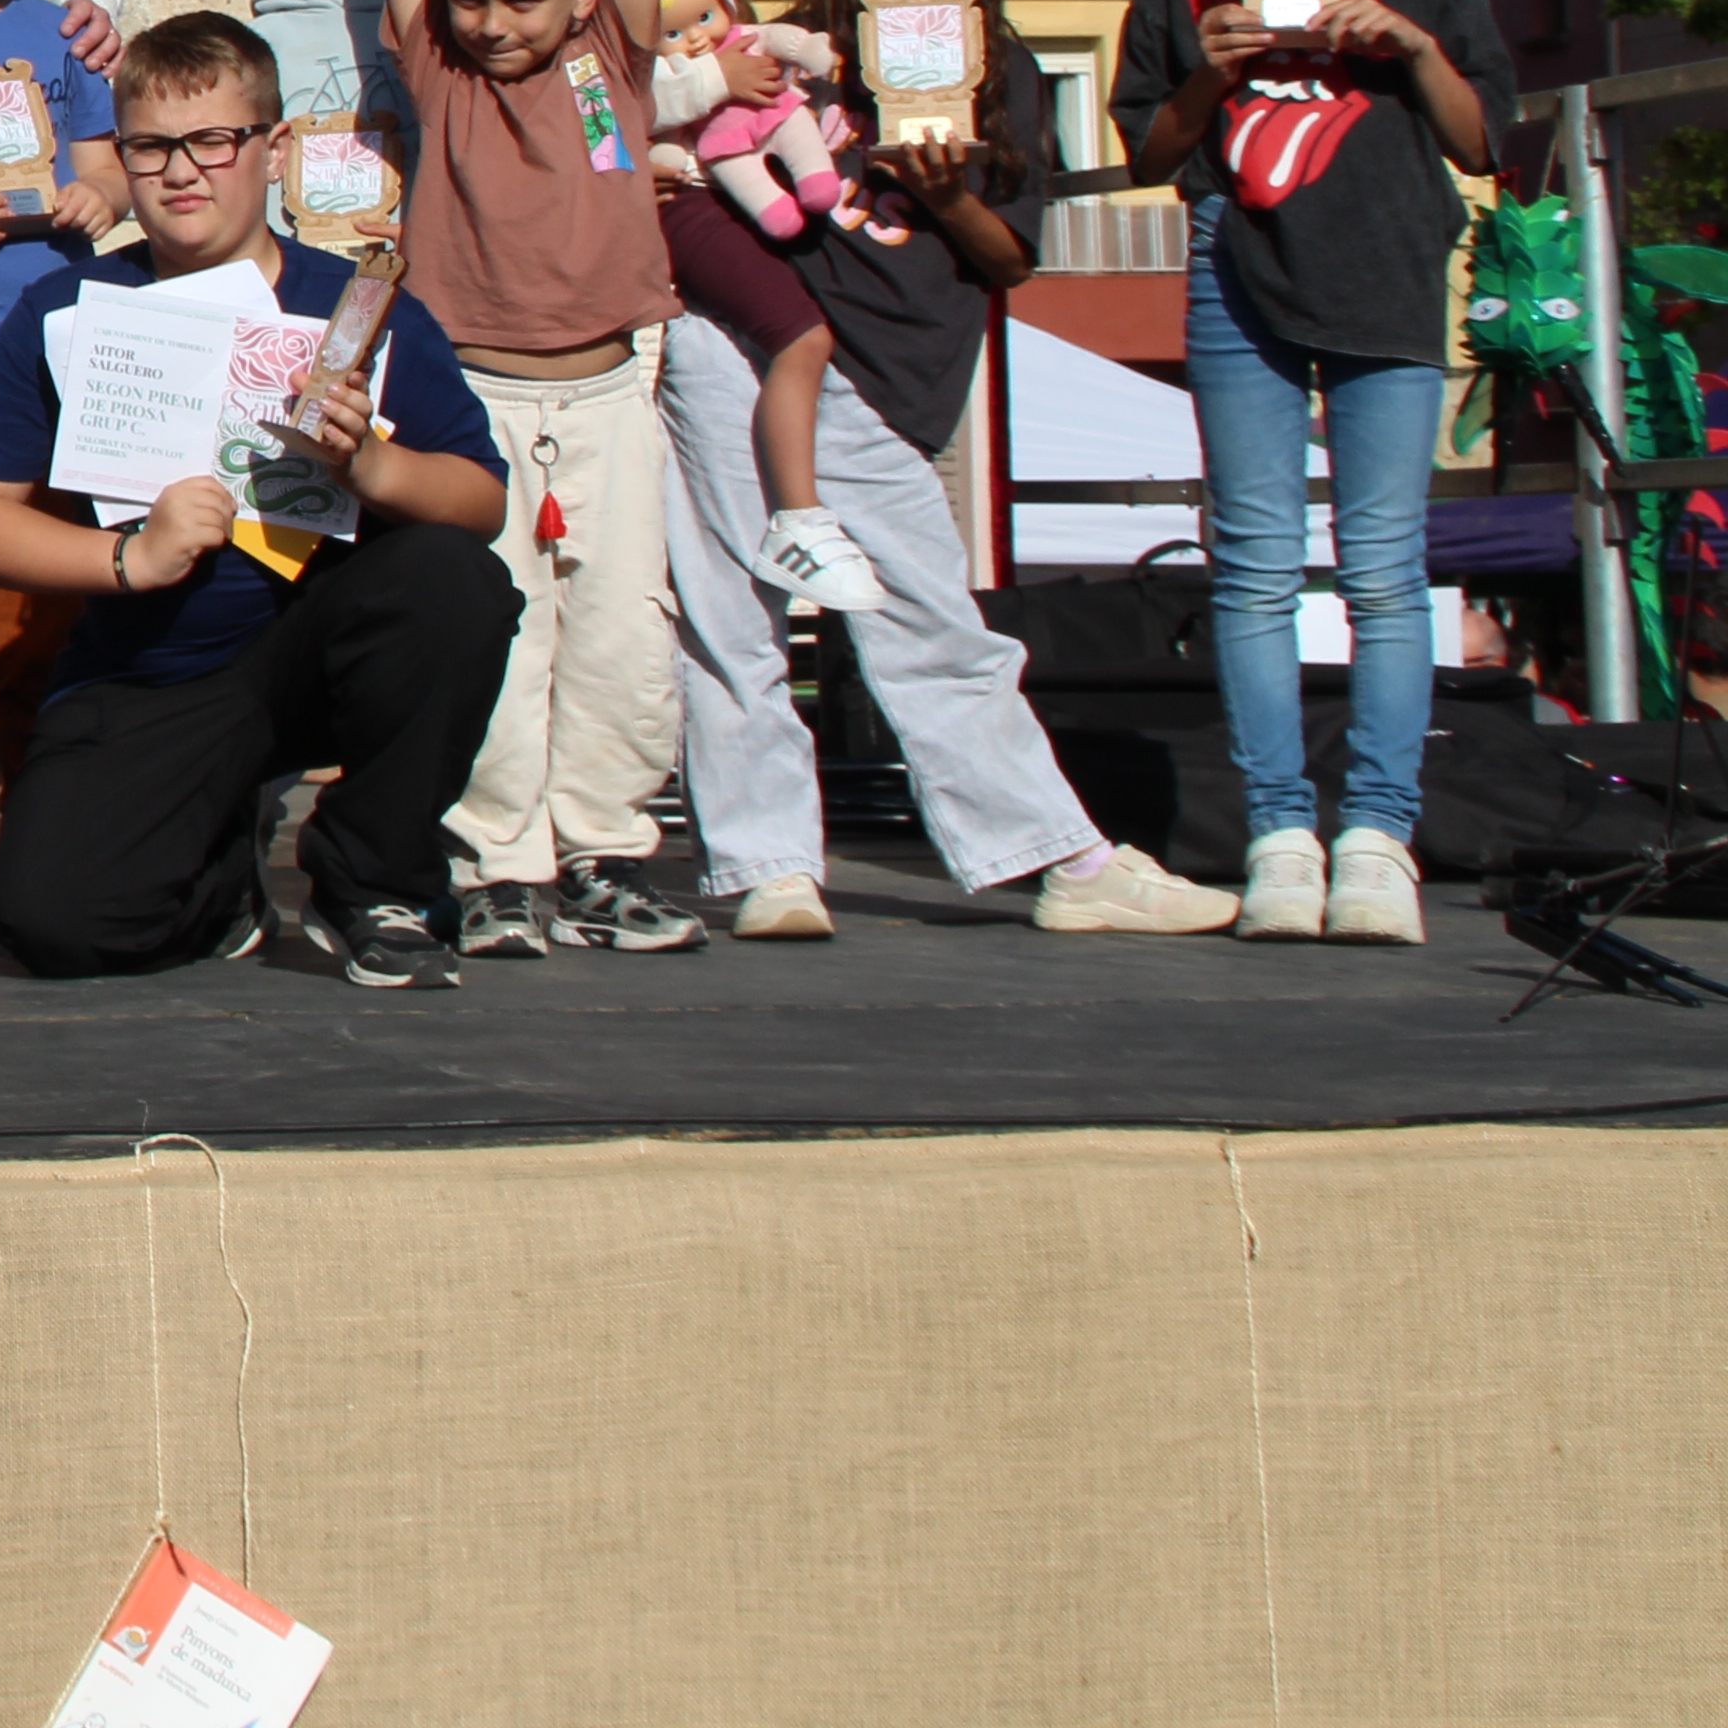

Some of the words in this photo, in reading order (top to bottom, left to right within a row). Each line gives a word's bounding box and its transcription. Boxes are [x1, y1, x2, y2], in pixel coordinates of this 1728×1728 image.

[90, 342, 136, 362] AITOR
[93, 326, 153, 343] L'AJUNTAMENT
[154, 337, 166, 346] DE
[168, 339, 206, 353] TORDERA
[88, 356, 164, 381] SALGUERO
[86, 378, 143, 401] SEGON
[146, 388, 204, 412] PREMI
[251, 392, 284, 402] TORDER
[82, 395, 106, 414] DE
[109, 399, 168, 424] PROSA
[80, 412, 128, 435] GRUP
[130, 421, 146, 436] C.
[74, 443, 87, 452] DE
[89, 445, 128, 459] LLIBRES
[76, 433, 119, 448] VALORAT
[121, 441, 133, 450] EN
[165, 450, 185, 460] LOT
[179, 1624, 236, 1669] Pinyons
[170, 1643, 189, 1662] de
[190, 1656, 253, 1703] maduixa
